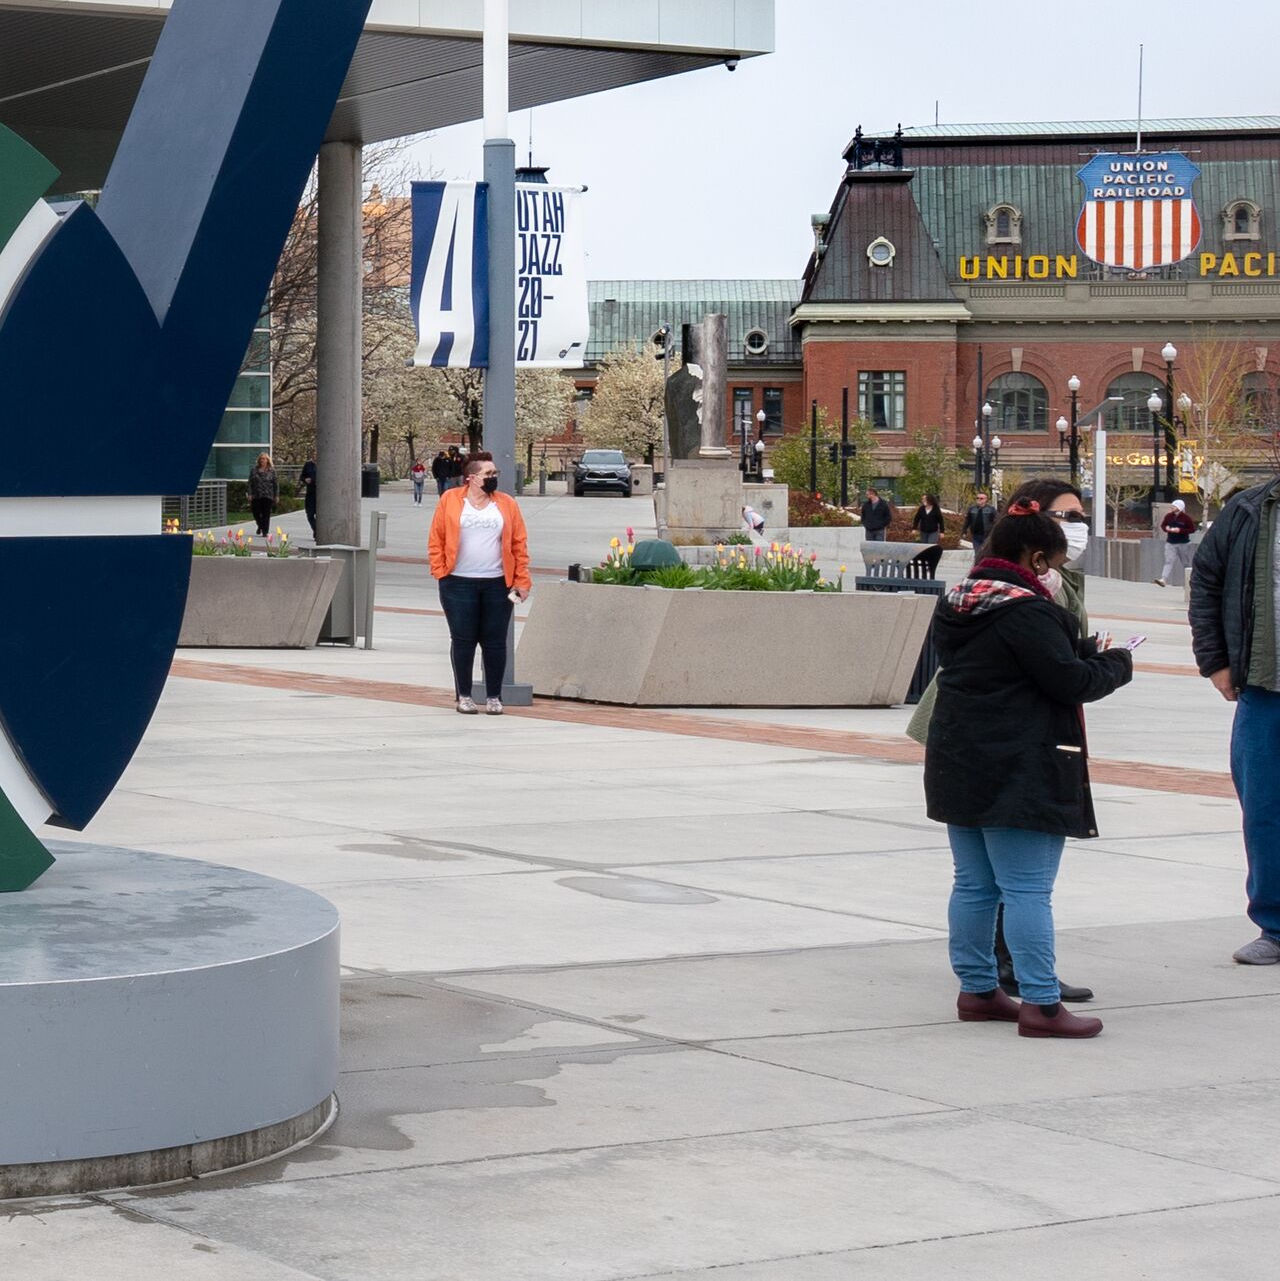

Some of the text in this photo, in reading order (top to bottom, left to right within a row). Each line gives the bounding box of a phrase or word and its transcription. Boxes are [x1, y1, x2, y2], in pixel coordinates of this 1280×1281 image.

[1103, 173, 1176, 184] PACIFIC
[1110, 160, 1168, 172] UNION
[1093, 186, 1185, 198] RAILROAD
[516, 189, 565, 233] UTAH
[518, 233, 563, 276] JAZZ
[959, 252, 1276, 279] UNION PACI
[516, 320, 538, 361] 21
